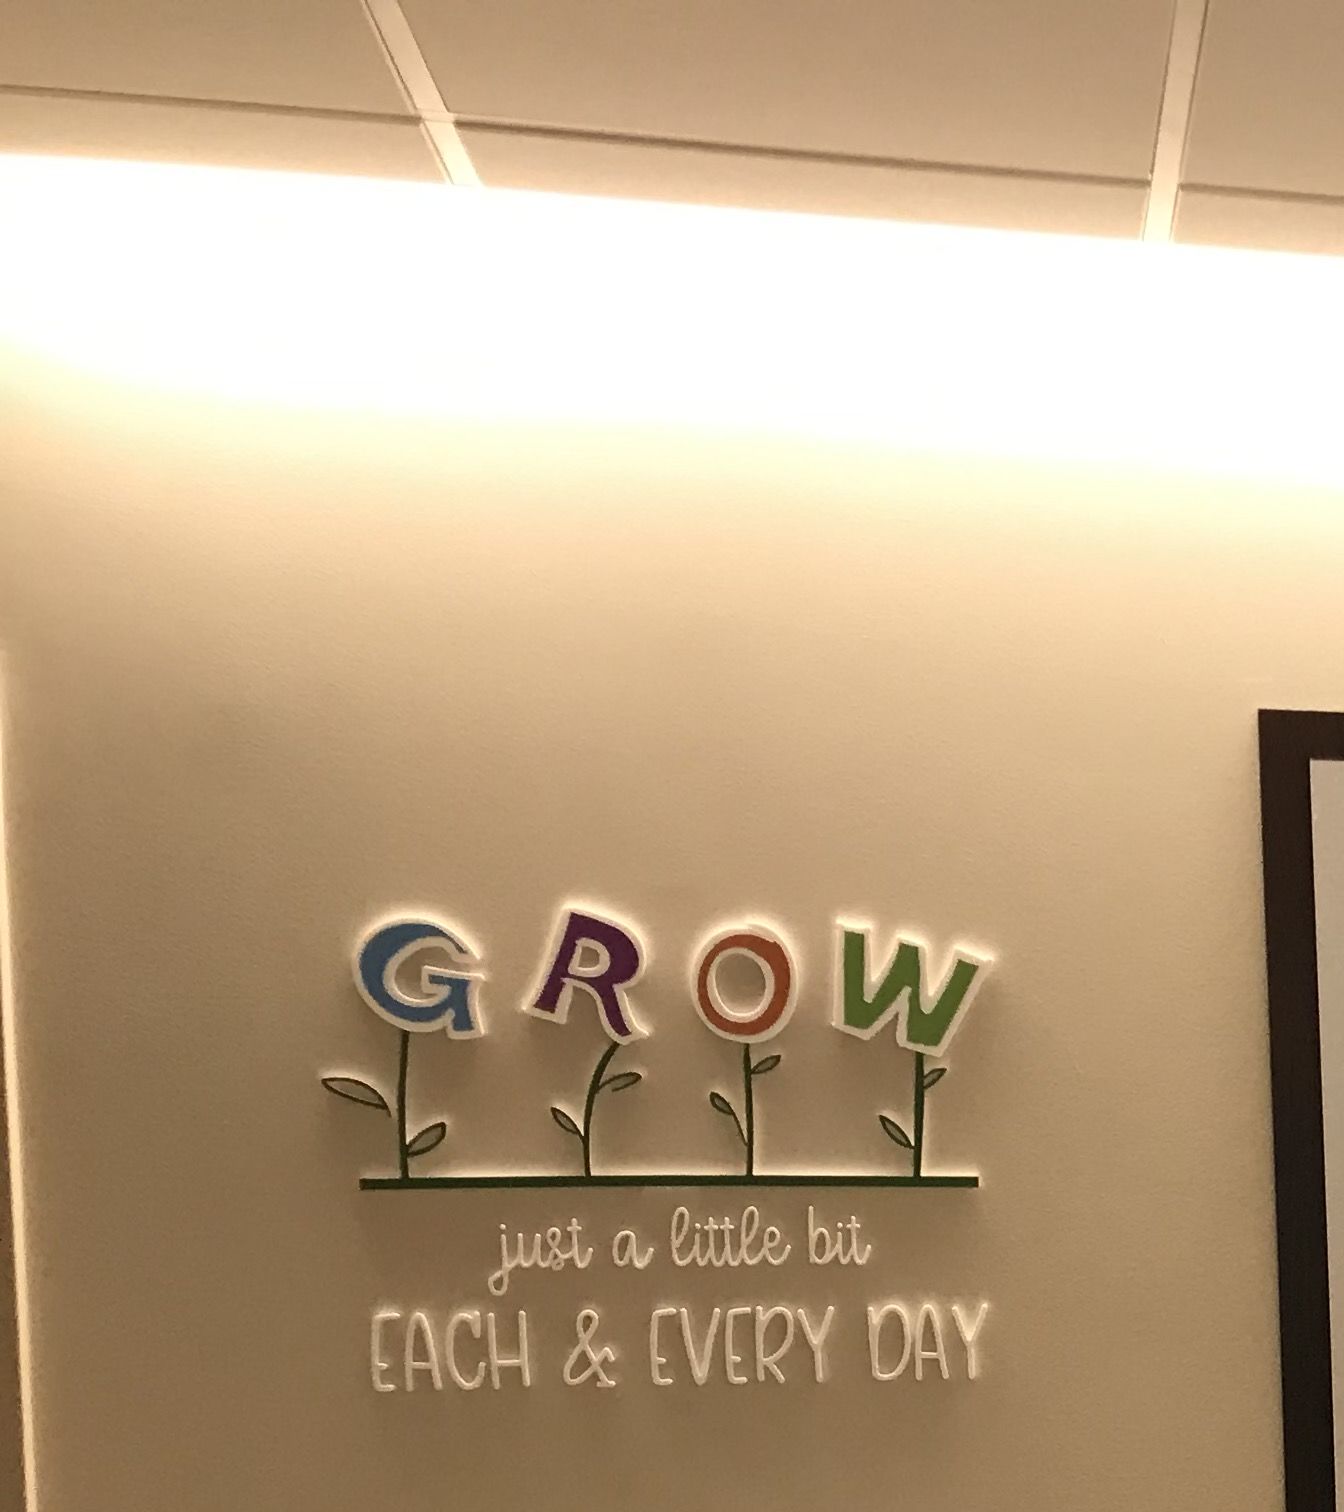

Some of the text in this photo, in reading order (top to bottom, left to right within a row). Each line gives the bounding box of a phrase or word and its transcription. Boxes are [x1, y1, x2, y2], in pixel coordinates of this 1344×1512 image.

[350, 903, 996, 1058] GROW
[487, 1205, 872, 1297] just a little bit
[369, 1301, 991, 1393] EACH & EVERY DAY
